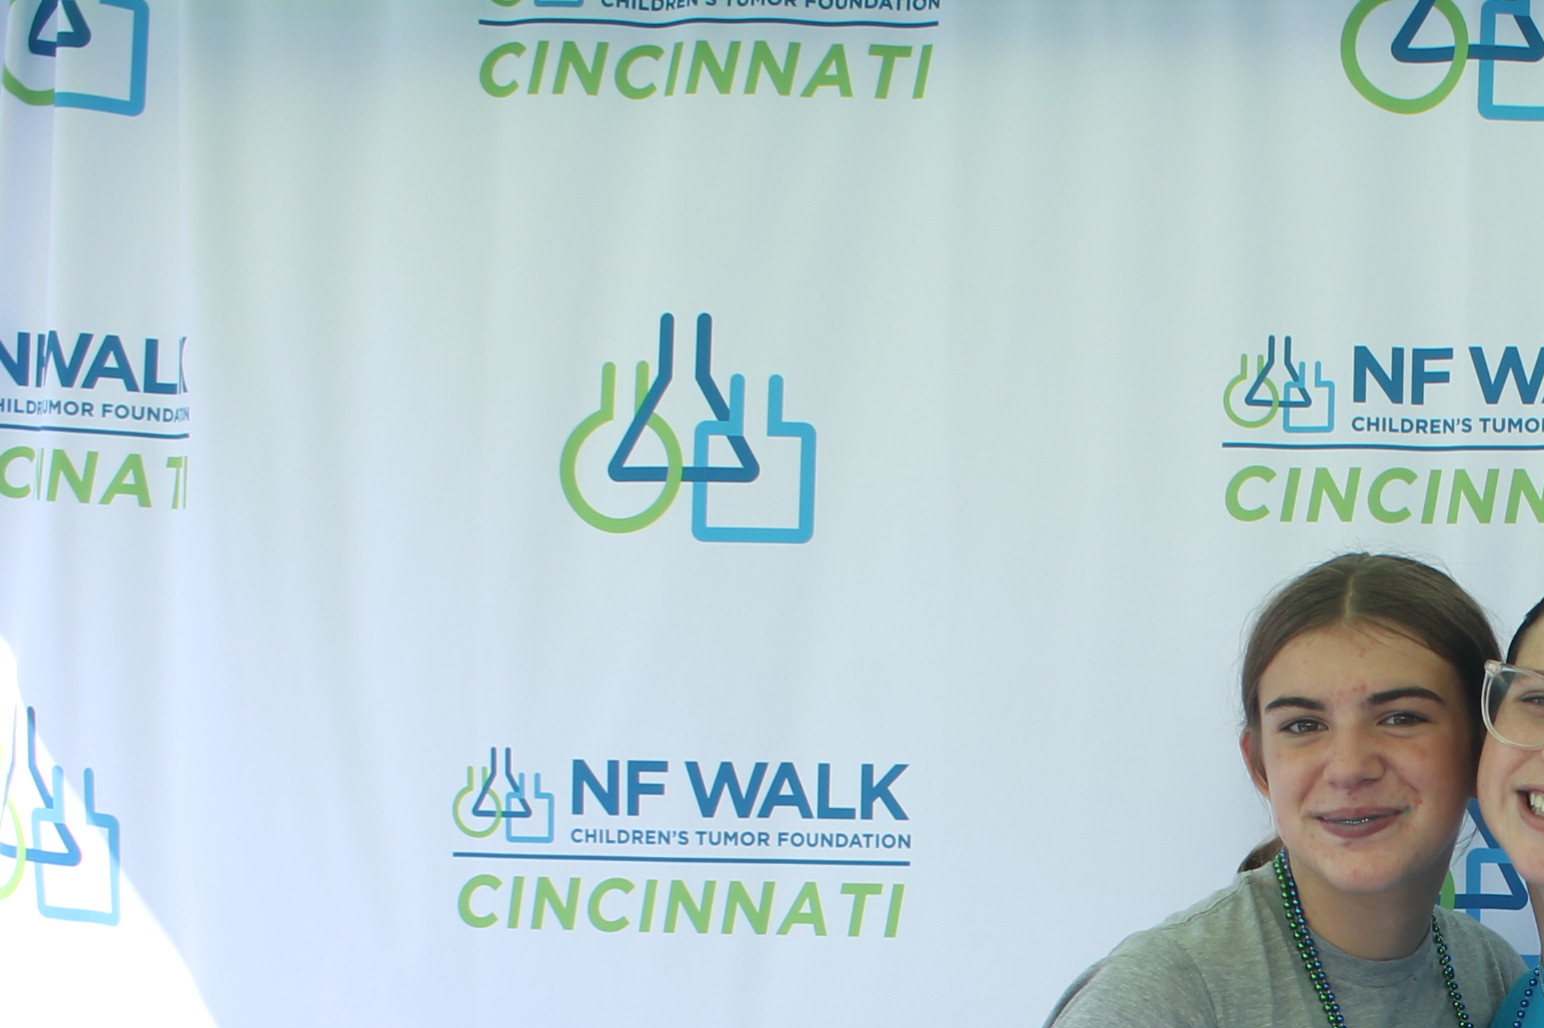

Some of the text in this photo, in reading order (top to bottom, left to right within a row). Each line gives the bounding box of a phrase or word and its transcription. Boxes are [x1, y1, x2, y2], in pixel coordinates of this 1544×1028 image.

[478, 40, 934, 100] CINCINNATI
[1353, 345, 1453, 405] NF
[1351, 416, 1473, 434] CHILDREN'S
[571, 759, 909, 821] NF WALK
[570, 828, 911, 849] CHILDREN'S TUMOR FOUNDATION
[457, 874, 905, 938] CINCINNATI
